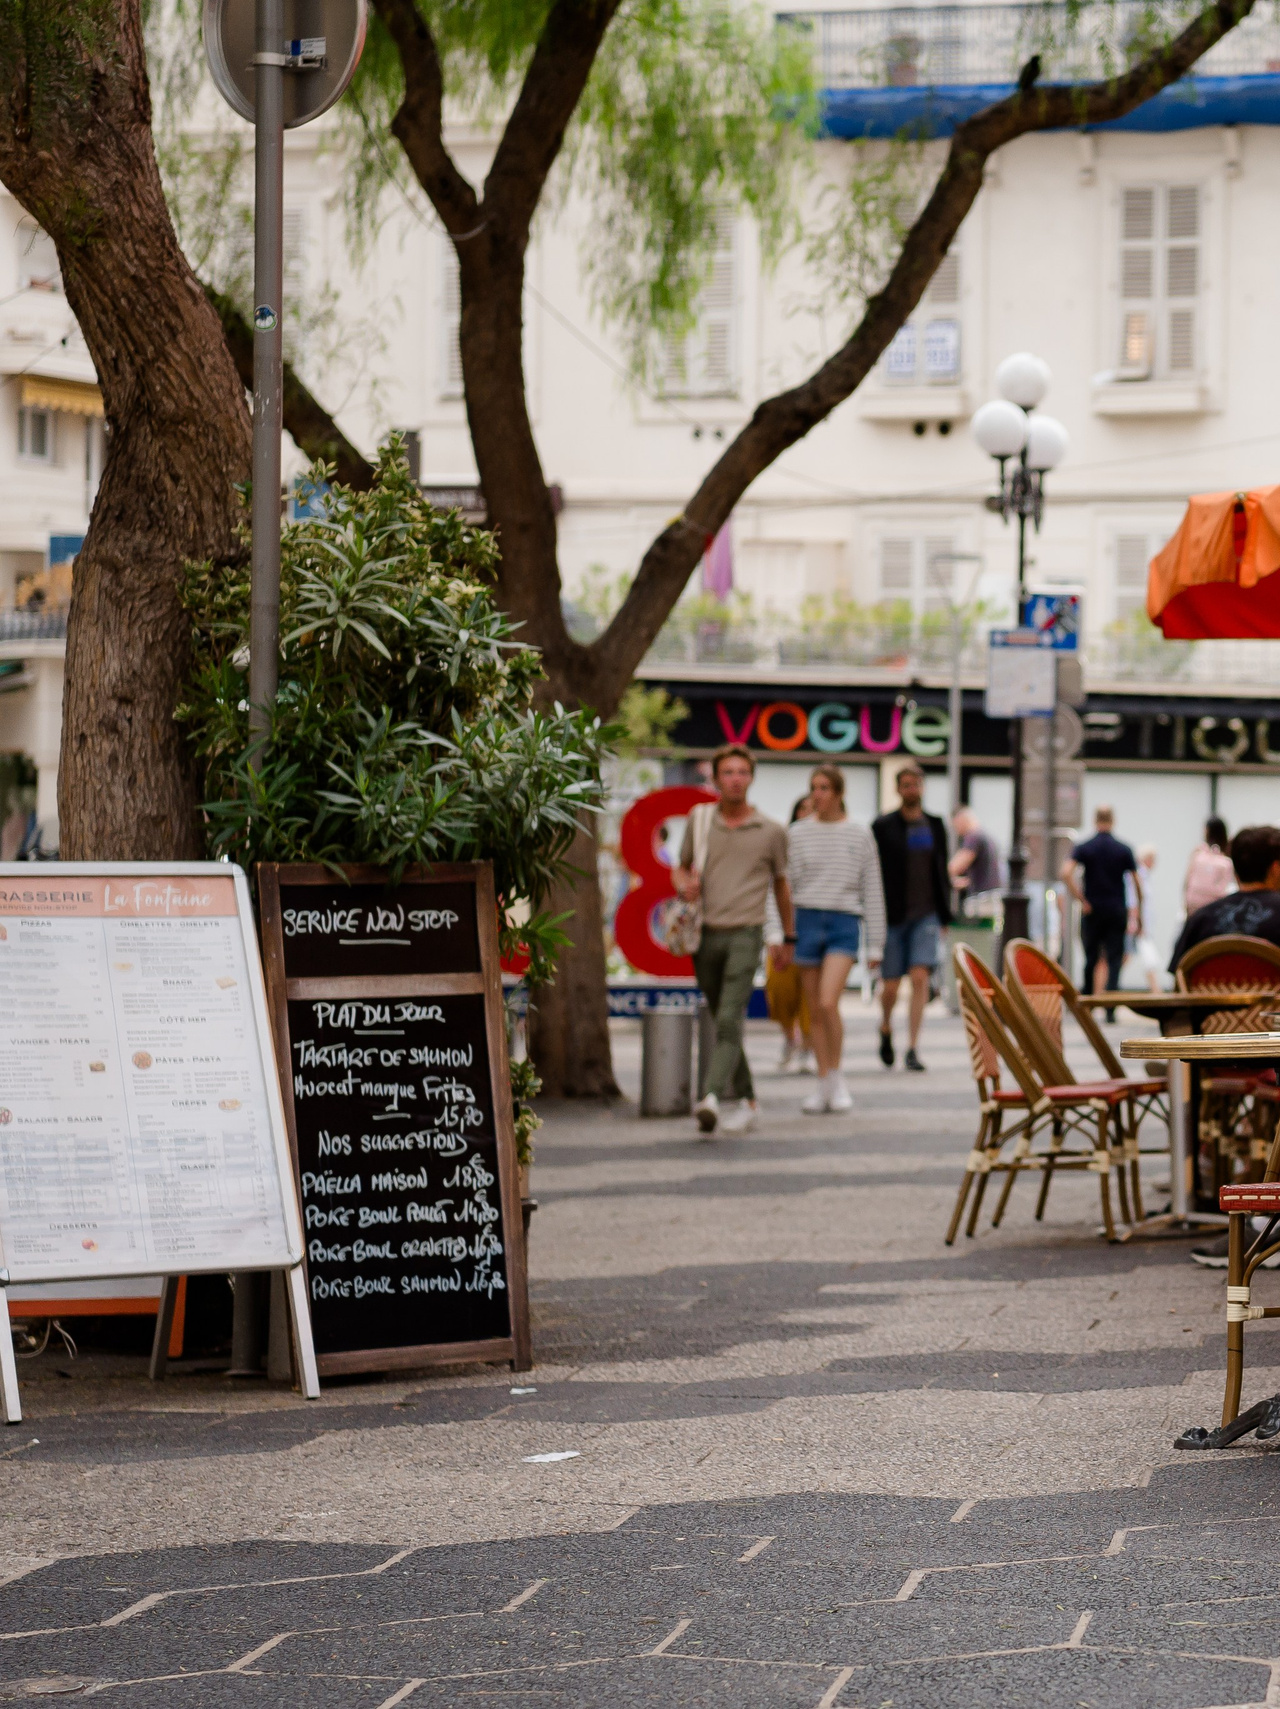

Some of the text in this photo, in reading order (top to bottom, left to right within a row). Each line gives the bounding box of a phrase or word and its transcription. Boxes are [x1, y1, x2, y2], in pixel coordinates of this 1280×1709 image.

[0, 881, 213, 915] RASSERIE La Fontaine
[366, 904, 405, 933] NON
[408, 909, 460, 932] STOP
[313, 1002, 446, 1029] PLAT DU JOUR
[294, 1040, 473, 1068] TARTARE DE SAUMON
[423, 1076, 476, 1104] Frites
[305, 1205, 354, 1229] POKE
[358, 1206, 402, 1228] BOWL
[352, 1239, 398, 1262] BOWL
[401, 1268, 461, 1295] SAUMON
